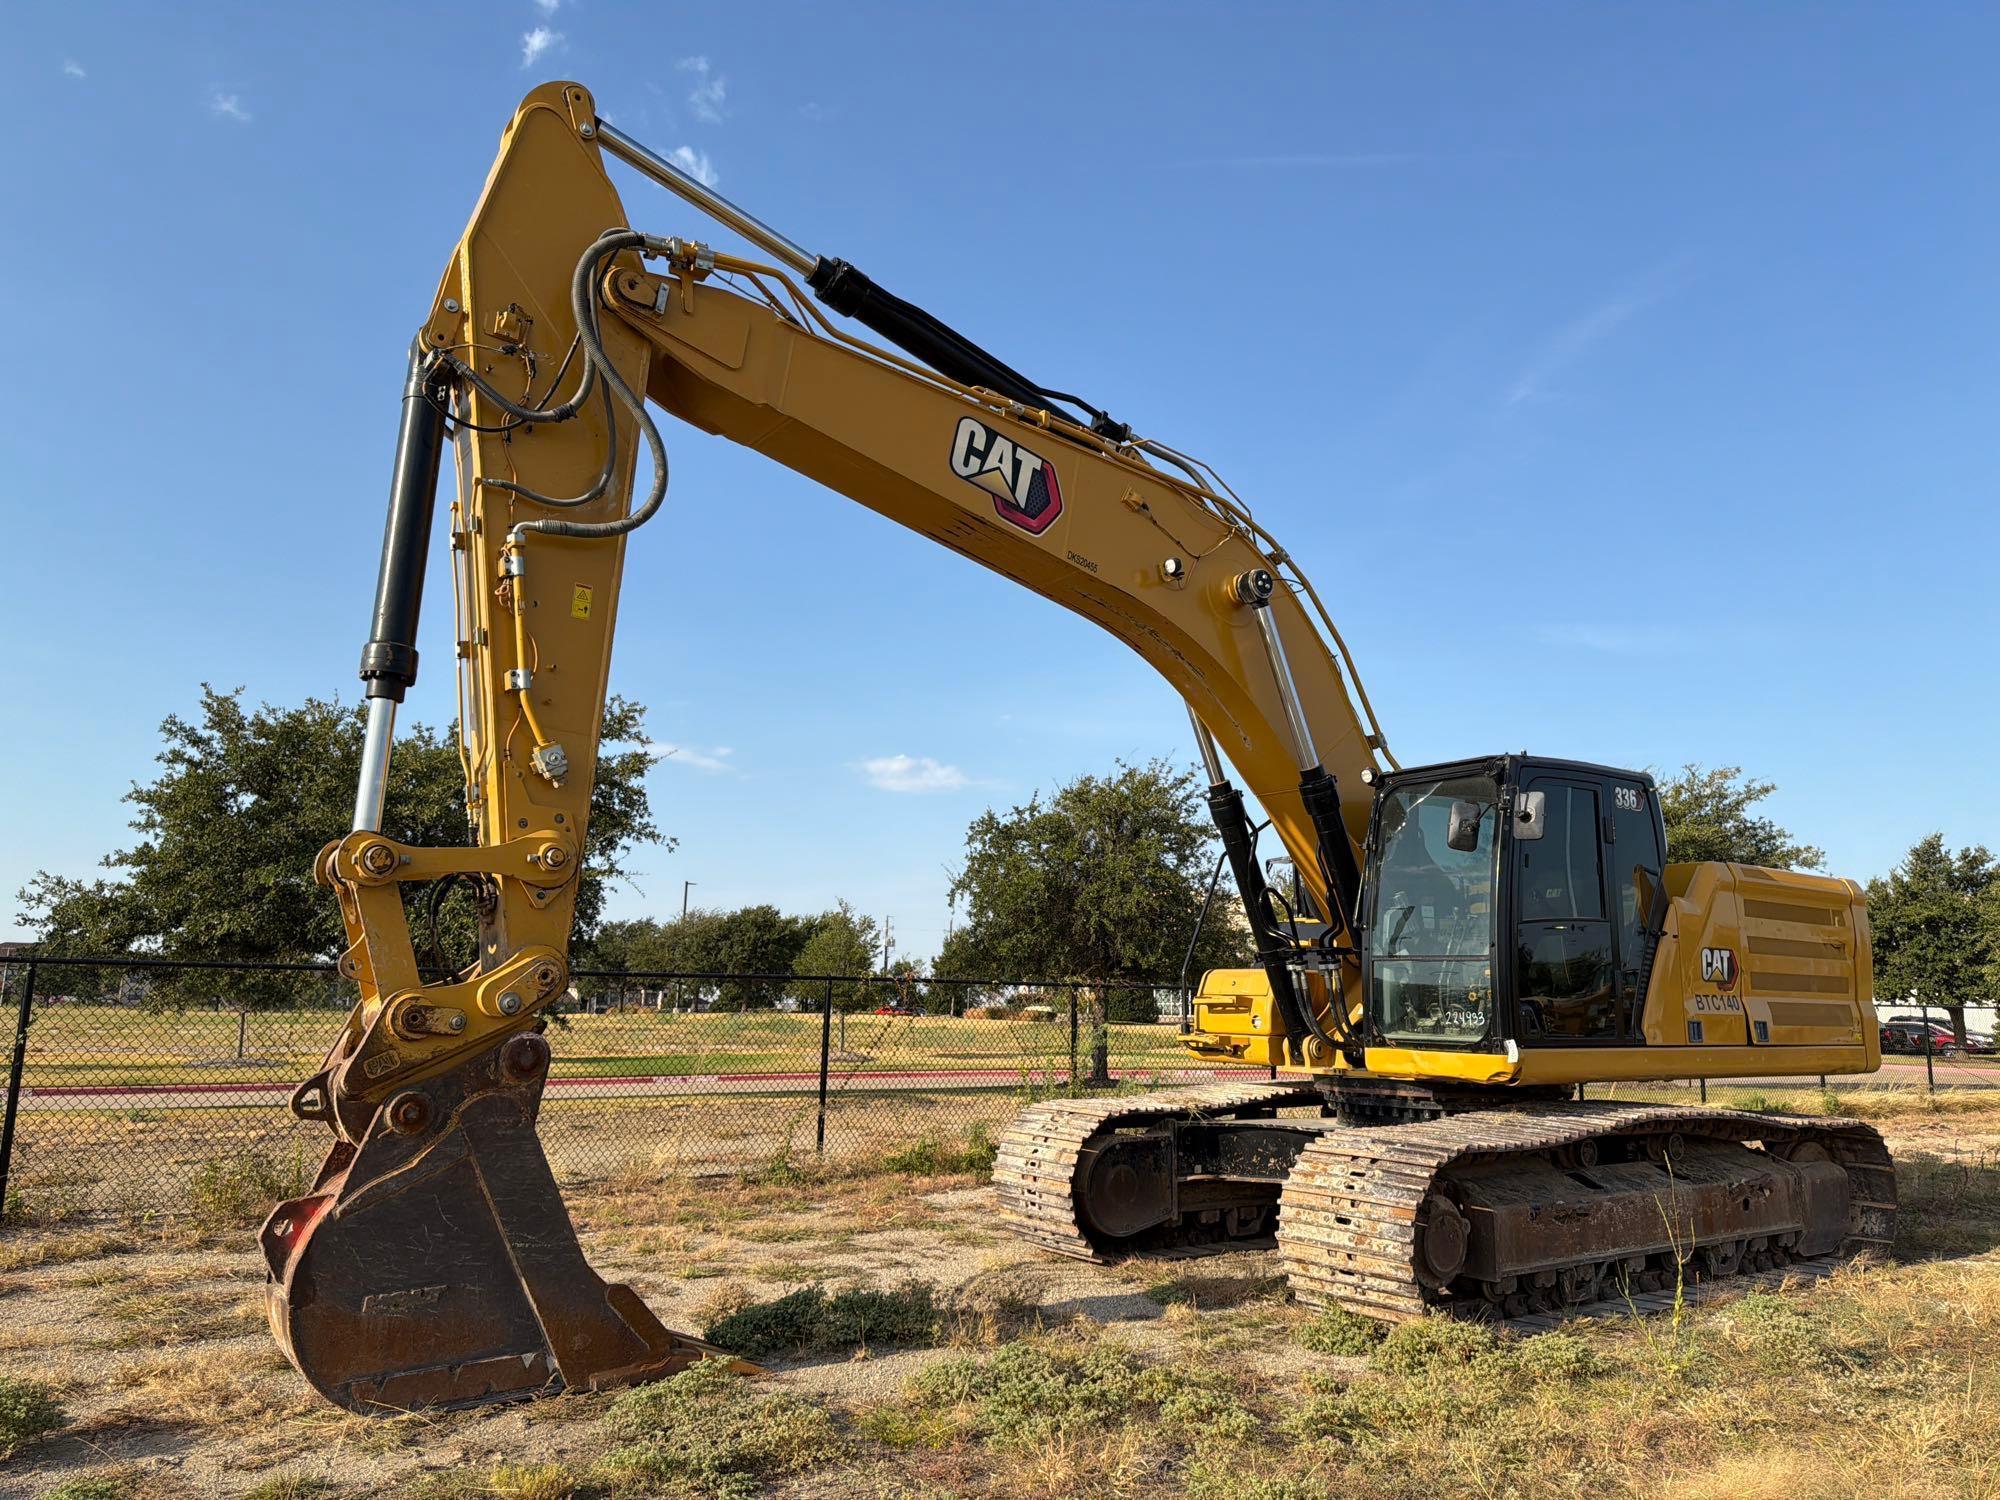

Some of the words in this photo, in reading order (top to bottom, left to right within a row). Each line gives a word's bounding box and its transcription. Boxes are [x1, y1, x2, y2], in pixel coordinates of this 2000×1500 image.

[951, 418, 1043, 509] CAT
[1614, 786, 1637, 808] 336
[1701, 947, 1731, 982] CAT
[1695, 994, 1740, 1011] BTC140
